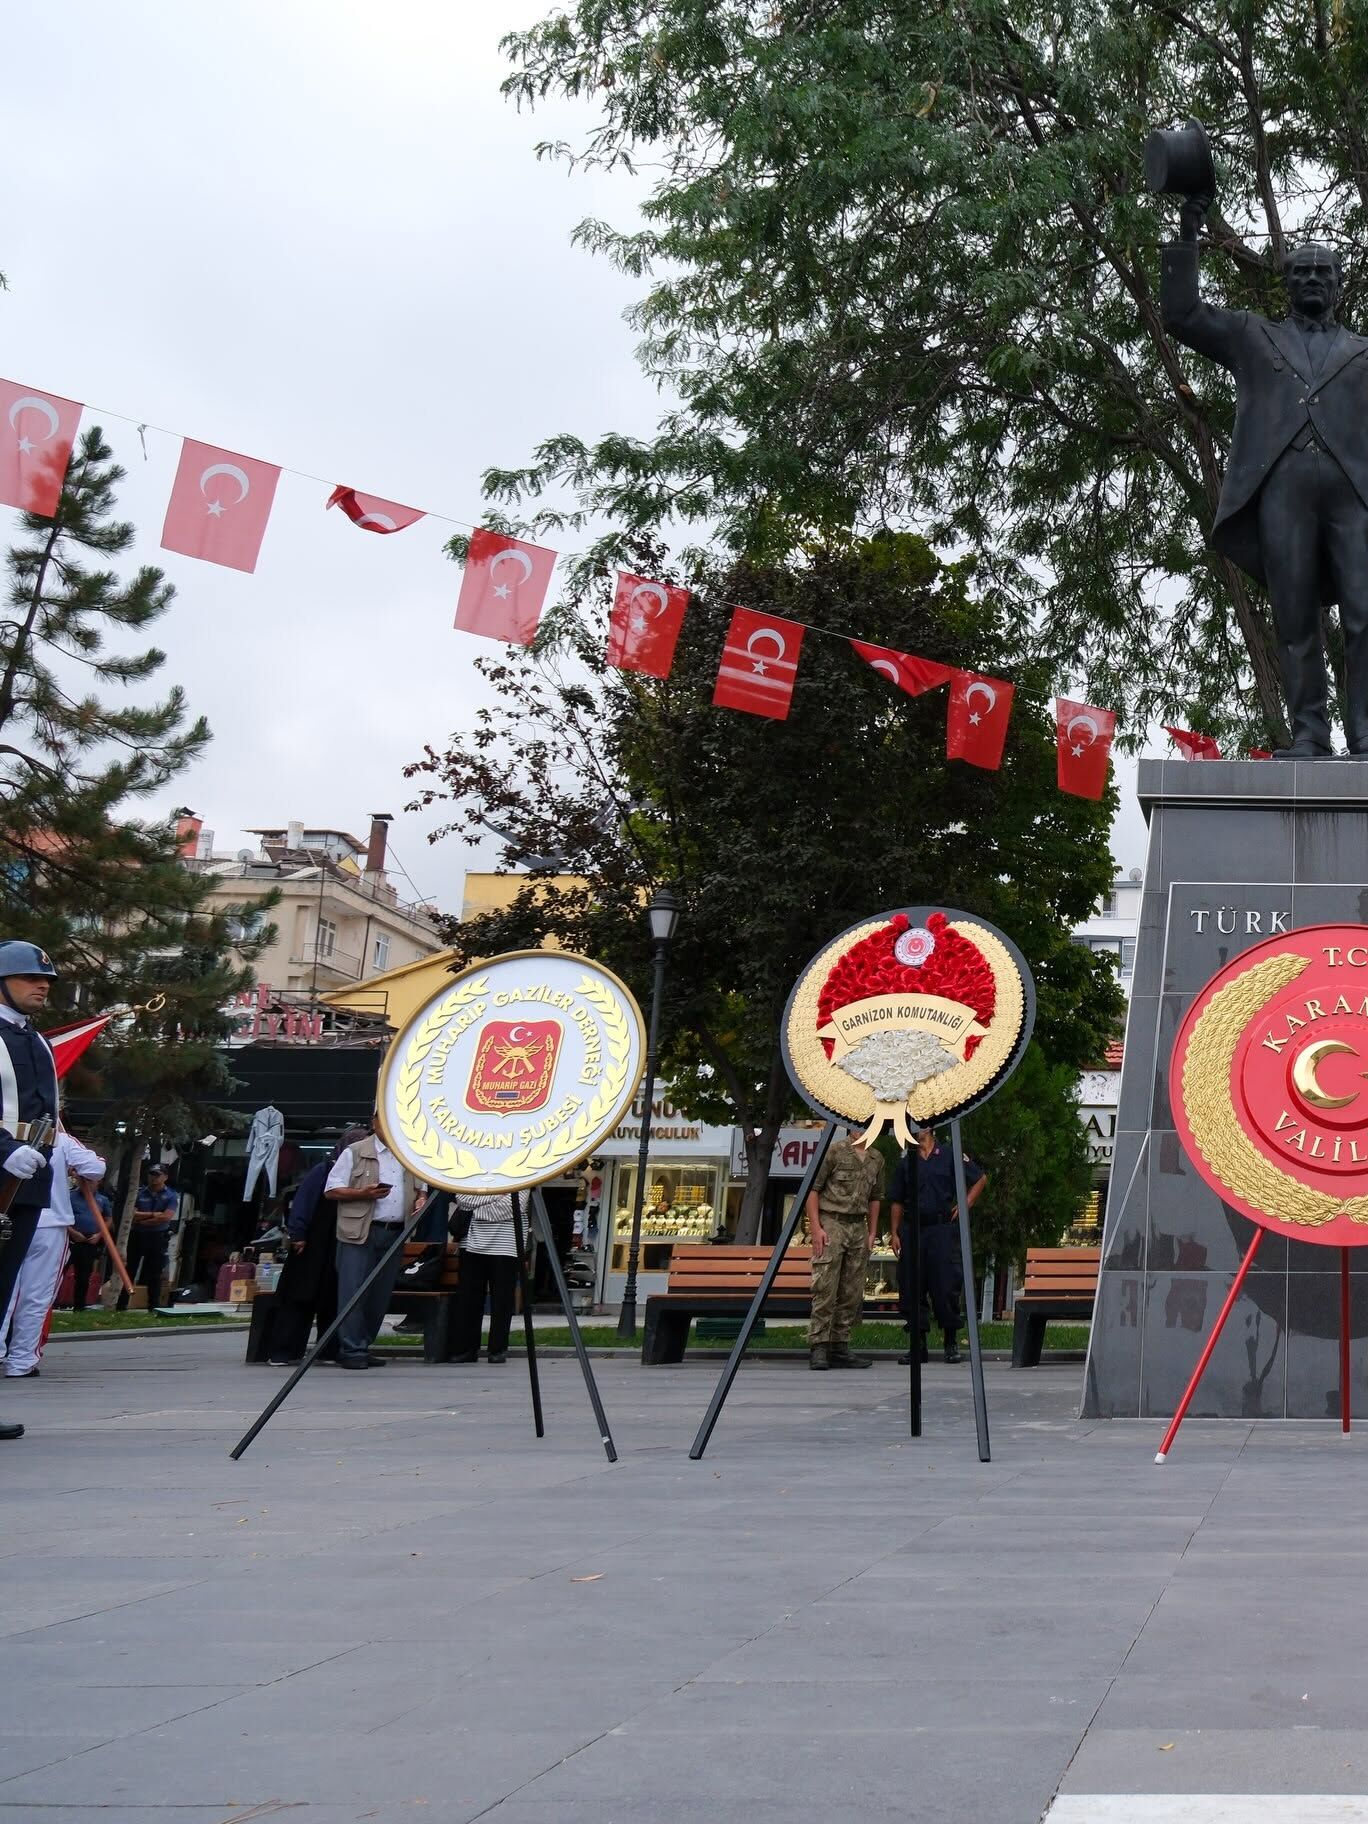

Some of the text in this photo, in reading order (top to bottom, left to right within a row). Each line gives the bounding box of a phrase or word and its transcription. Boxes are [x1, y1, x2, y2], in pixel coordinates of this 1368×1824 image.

[1190, 906, 1291, 934] TÜRK
[841, 1006, 964, 1032] GARNİZON KOMUTANLIĞI
[427, 984, 603, 1086] MUHARİP GAZİLER DERNEĞİ
[482, 1080, 518, 1090] MUHARİP
[428, 1093, 584, 1149] KARAMAN ŞUBESİ
